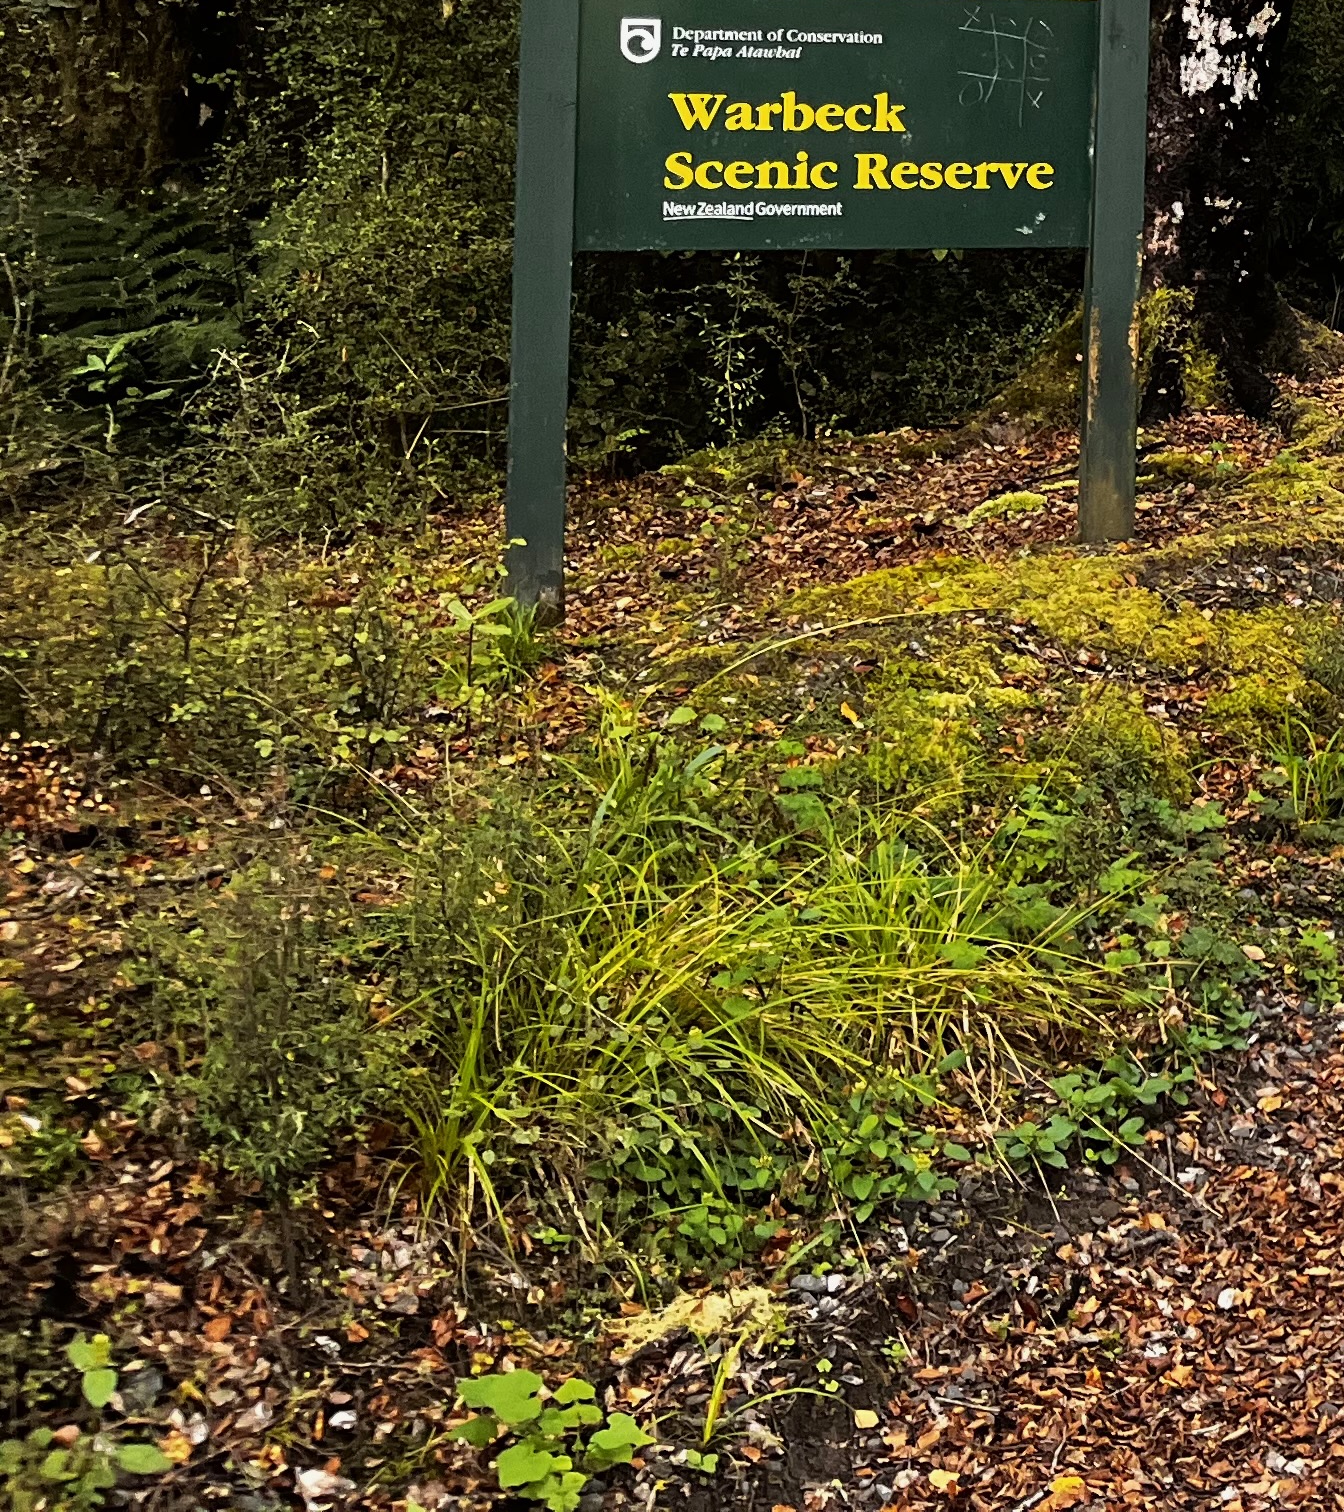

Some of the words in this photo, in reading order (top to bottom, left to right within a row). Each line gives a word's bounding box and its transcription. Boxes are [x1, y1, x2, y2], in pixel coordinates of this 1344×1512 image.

[671, 27, 763, 46] Department
[766, 28, 785, 42] of
[786, 29, 883, 45] Conservation
[671, 44, 690, 57] Te
[692, 44, 733, 61] Papa
[667, 91, 907, 132] Warbeck
[663, 151, 838, 190] Scenic
[852, 153, 1055, 190] Reserve
[663, 201, 696, 217] New
[697, 201, 754, 217] Zealand
[755, 201, 843, 217] Government
